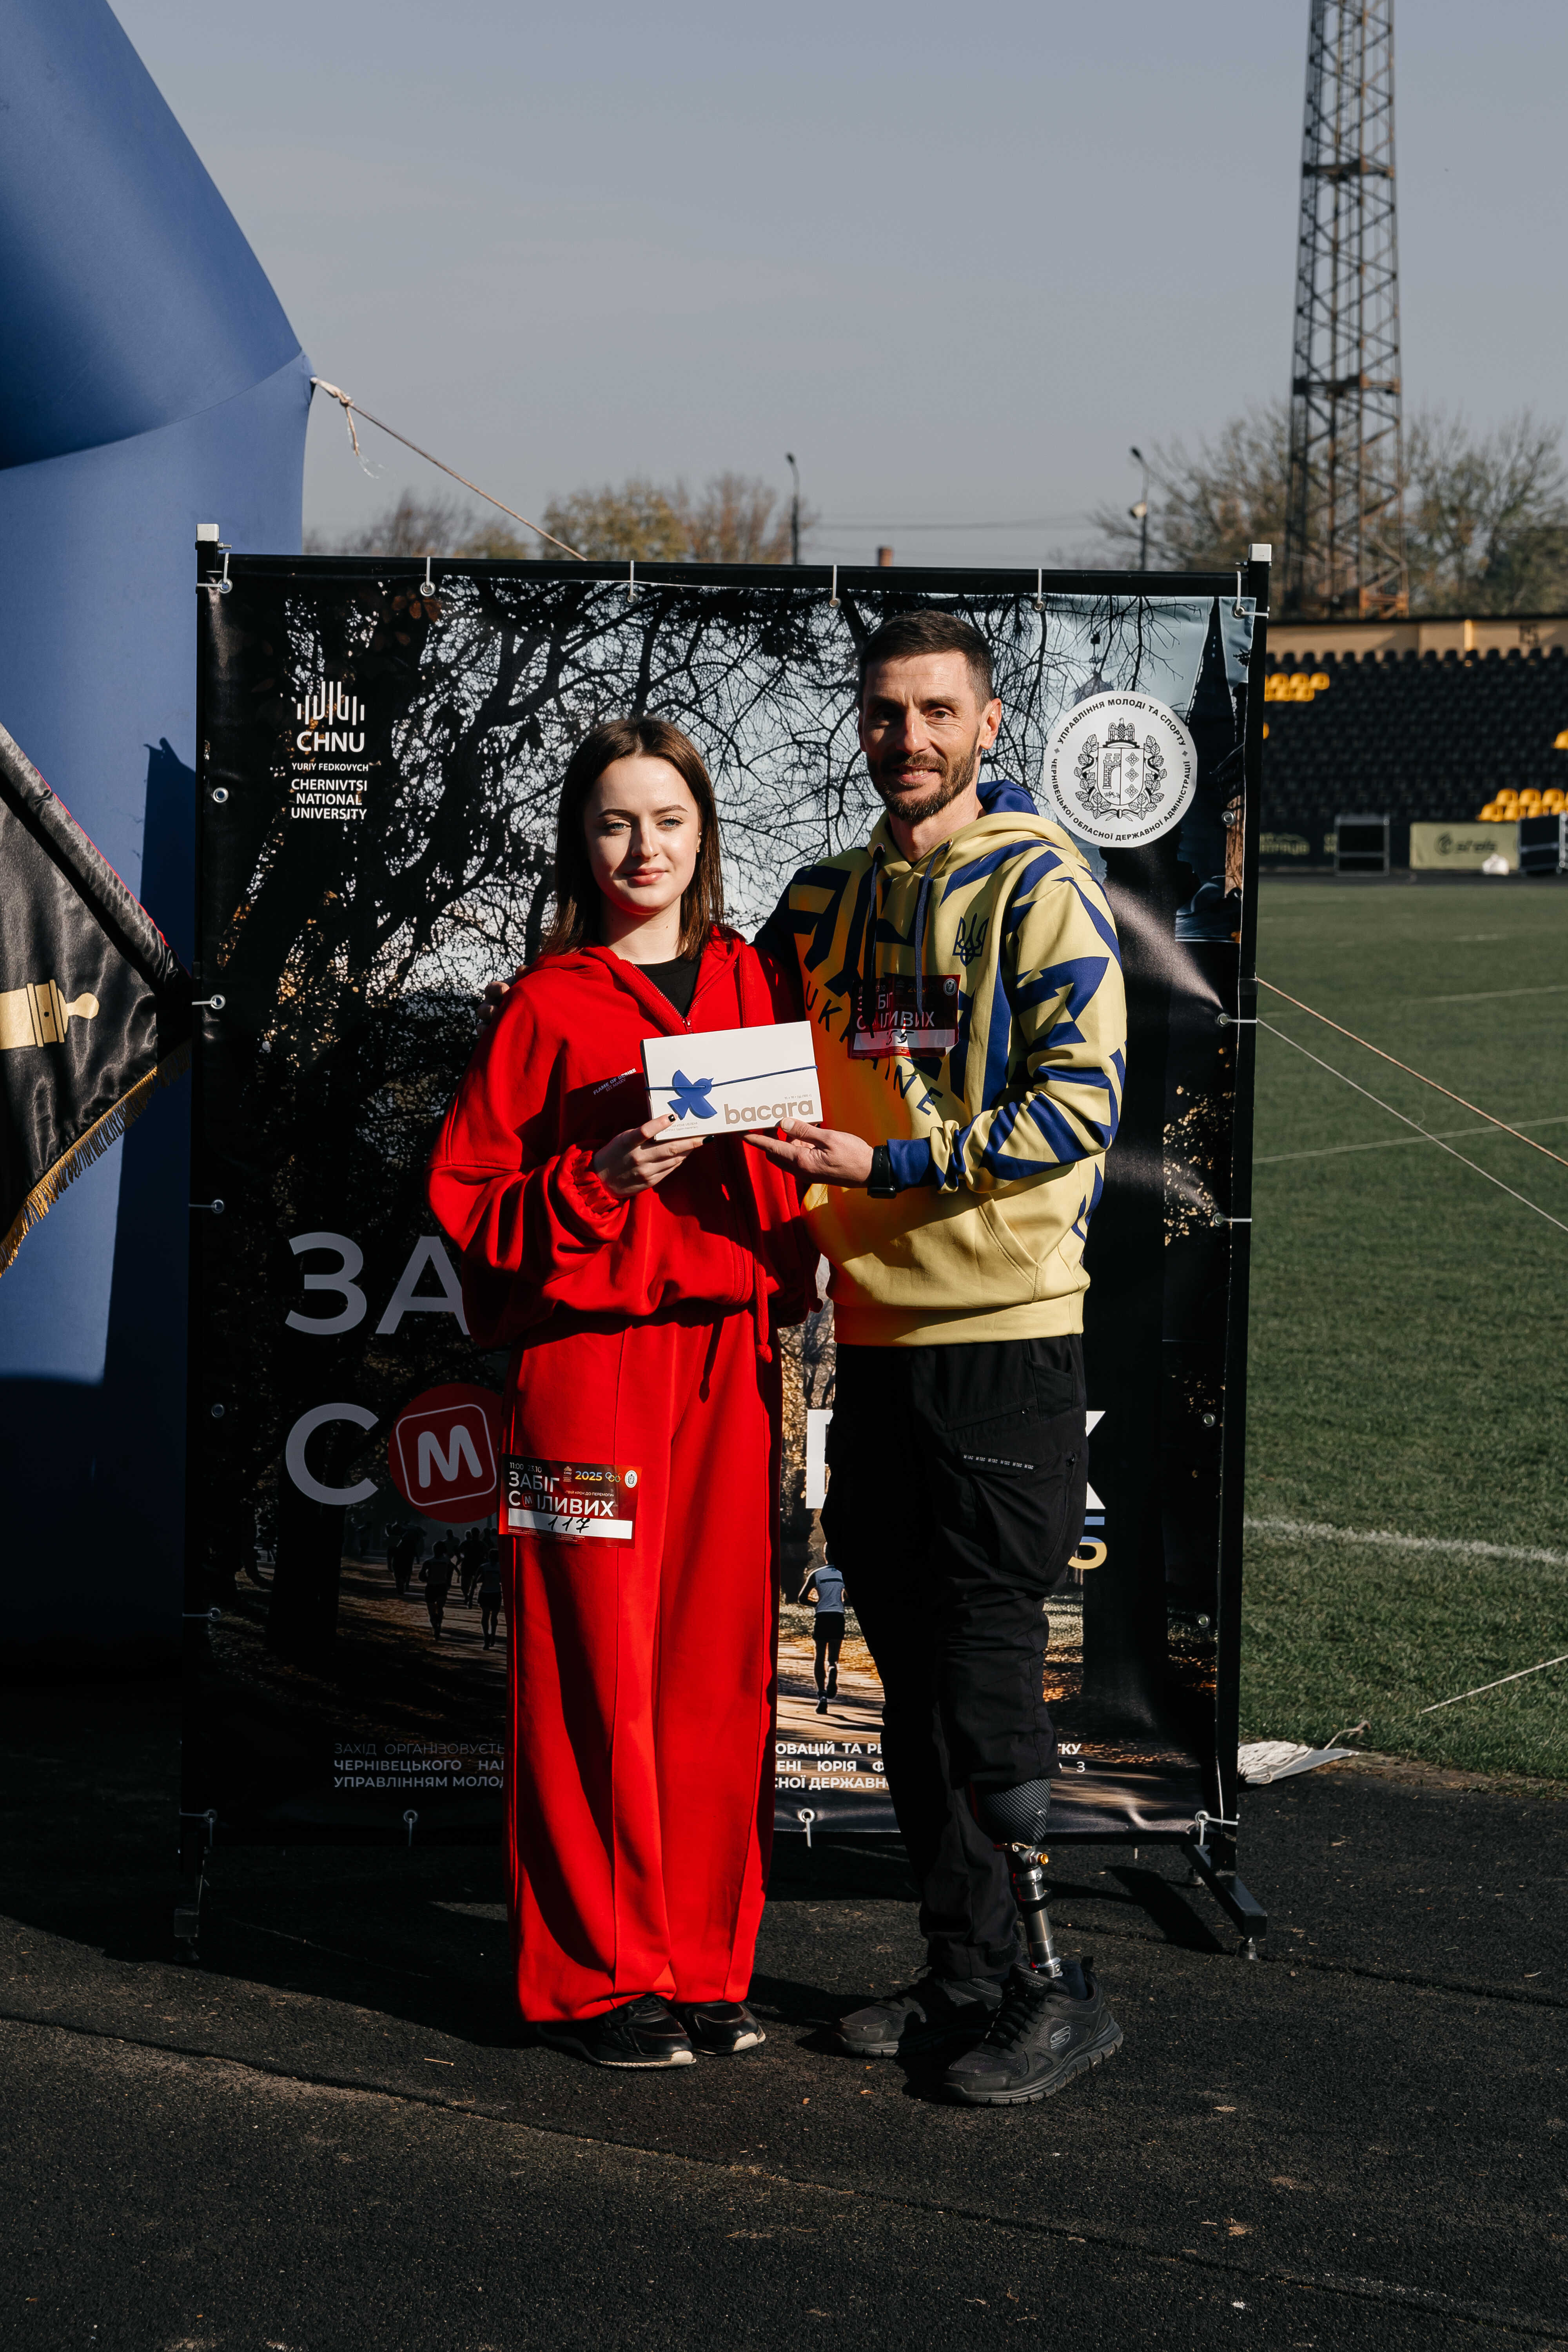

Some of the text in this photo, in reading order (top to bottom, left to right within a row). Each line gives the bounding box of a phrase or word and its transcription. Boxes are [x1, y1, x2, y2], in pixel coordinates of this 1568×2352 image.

[1058, 699, 1186, 746] УПРАВЛІННЯ МОЛОДІ ТА СПОРТУ
[297, 731, 365, 752] CHNU
[292, 762, 368, 771] YURIY FEDKOVYCH
[291, 779, 367, 791] CHERNIVTSI
[296, 793, 362, 805] NATIONAL
[1051, 759, 1191, 841] ЧЕРНІВЕЦЬКОЇ ОБЛАСНОЇ ДЕРЖАВНОЇ АДМІНІСТРАЦІЇ
[291, 808, 367, 820] UNIVERSITY
[857, 1011, 935, 1030] СІЛИВИХ
[593, 1082, 609, 1095] FLAME
[618, 1068, 637, 1080] DESIRE
[724, 1100, 814, 1124] bacara
[508, 1471, 560, 1493] ЗАБІГ
[575, 1471, 603, 1481] 2025
[548, 1516, 590, 1533] 117
[334, 1743, 505, 1756] ЗАХІД ОРГАНІЗОВУЄТЬ
[775, 1740, 835, 1756] ОВАЦІЙ
[842, 1743, 862, 1754] ТА
[334, 1760, 462, 1772] ЧЕРНІВЕЦЬКОГО
[777, 1760, 857, 1772] ЕНІ ЮРІЯ
[334, 1777, 503, 1788] УПРАВЛІННЯМ МОЛО
[808, 1777, 889, 1790] ДЕРЖАВН
